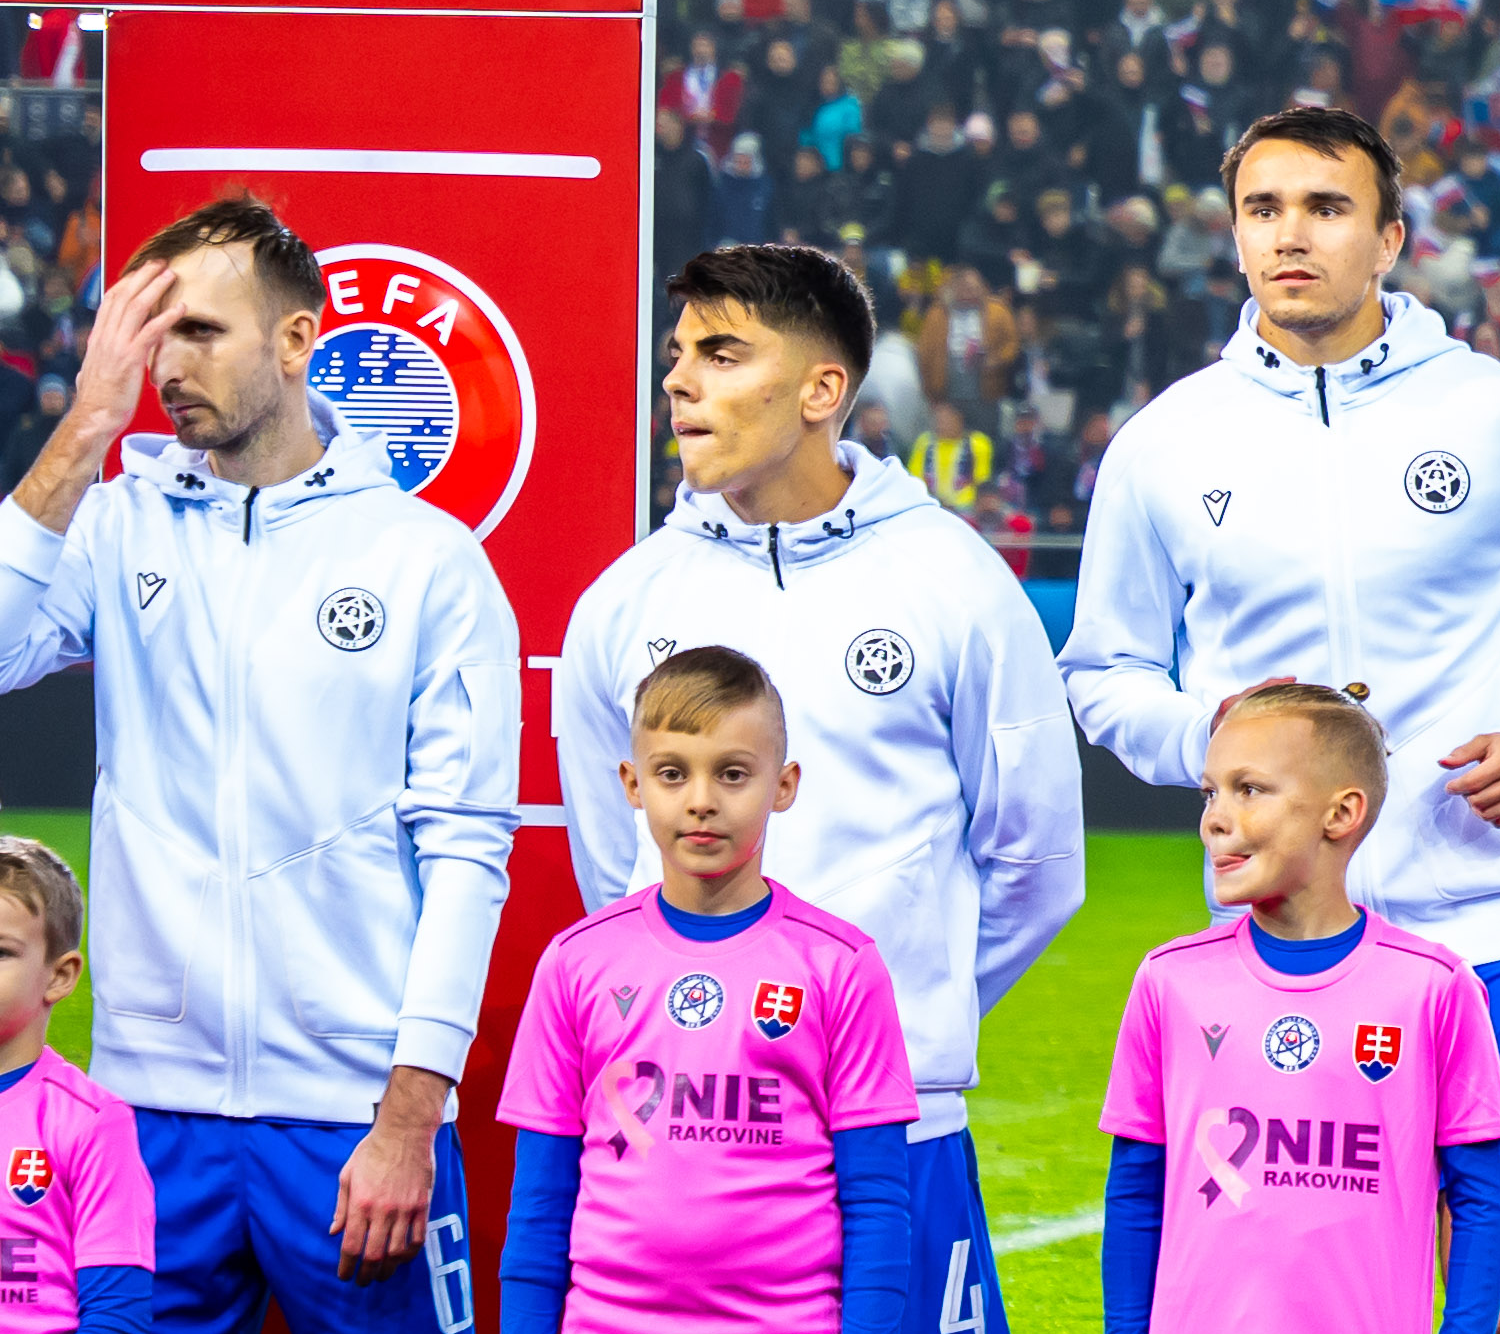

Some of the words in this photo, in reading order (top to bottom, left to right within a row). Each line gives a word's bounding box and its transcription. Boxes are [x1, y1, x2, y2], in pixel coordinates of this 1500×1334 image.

[327, 269, 459, 347] EFA
[673, 1072, 782, 1122] NIE
[667, 1123, 783, 1145] RAKOVINE
[1264, 1118, 1380, 1171] NIE
[1263, 1170, 1380, 1195] RAKOVINE
[428, 1213, 475, 1334] 6
